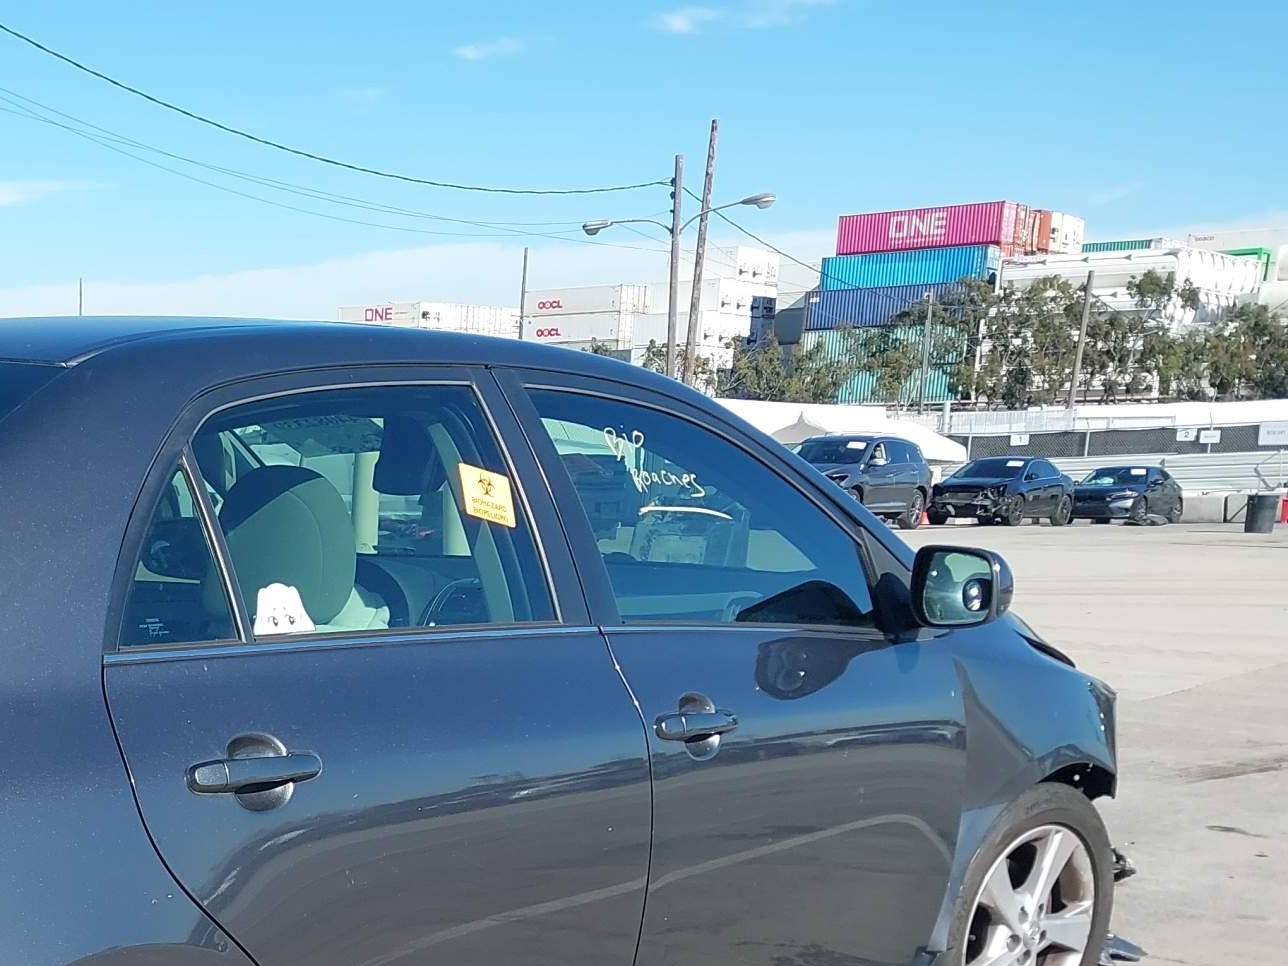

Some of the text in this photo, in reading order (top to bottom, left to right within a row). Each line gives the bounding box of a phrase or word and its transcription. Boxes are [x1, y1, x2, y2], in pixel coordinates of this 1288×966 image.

[889, 210, 948, 239] ONE
[537, 300, 563, 310] OOCL
[364, 307, 393, 322] ONE
[536, 327, 562, 338] OOCL
[1183, 431, 1190, 439] 2
